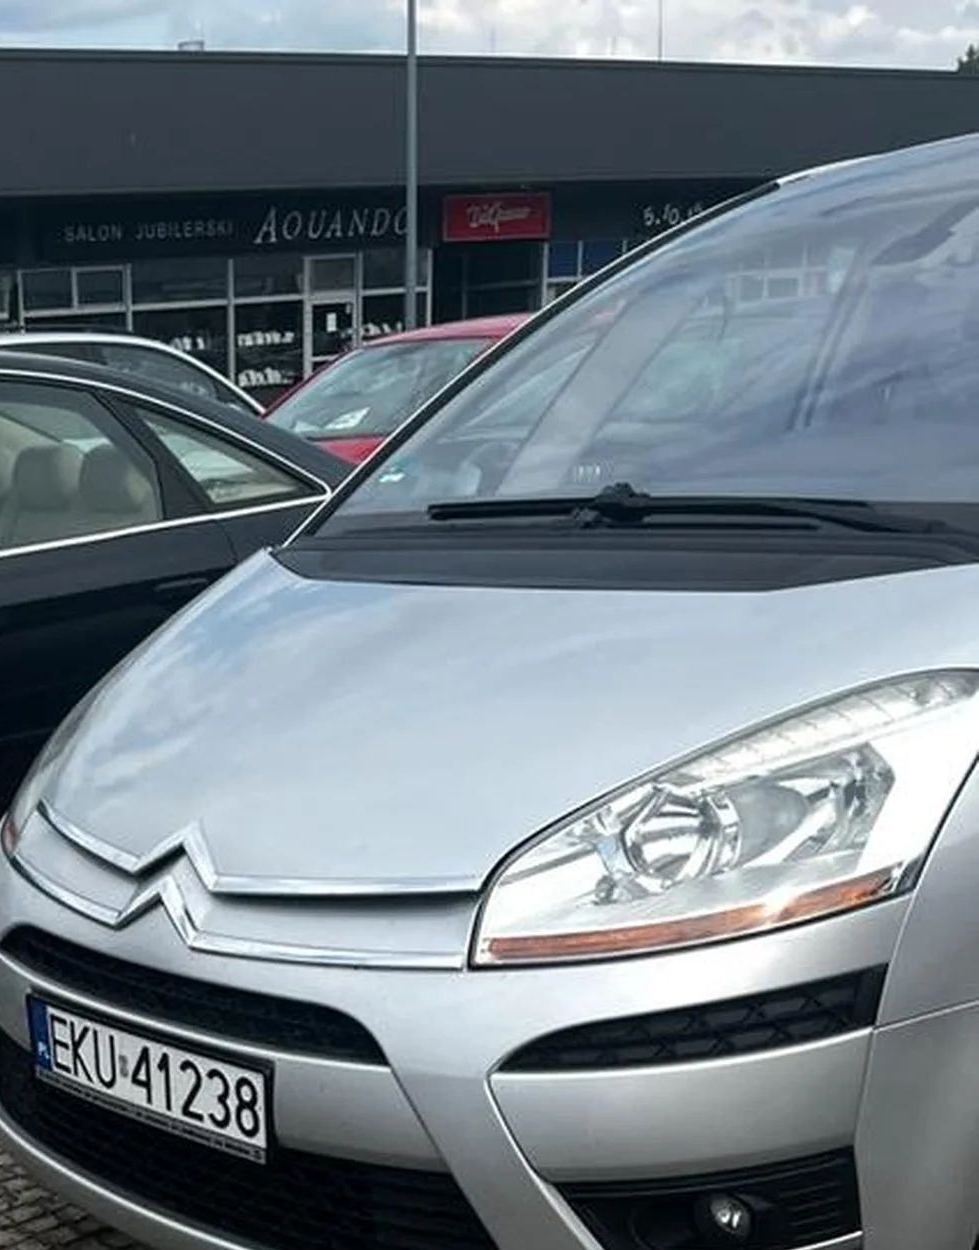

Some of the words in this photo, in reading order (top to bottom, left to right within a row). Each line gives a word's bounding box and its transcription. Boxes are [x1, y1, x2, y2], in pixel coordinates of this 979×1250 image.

[64, 223, 121, 242] SALON
[135, 219, 233, 240] JUBILERSKI
[49, 1013, 118, 1090] EKU
[131, 1045, 261, 1139] 41238
